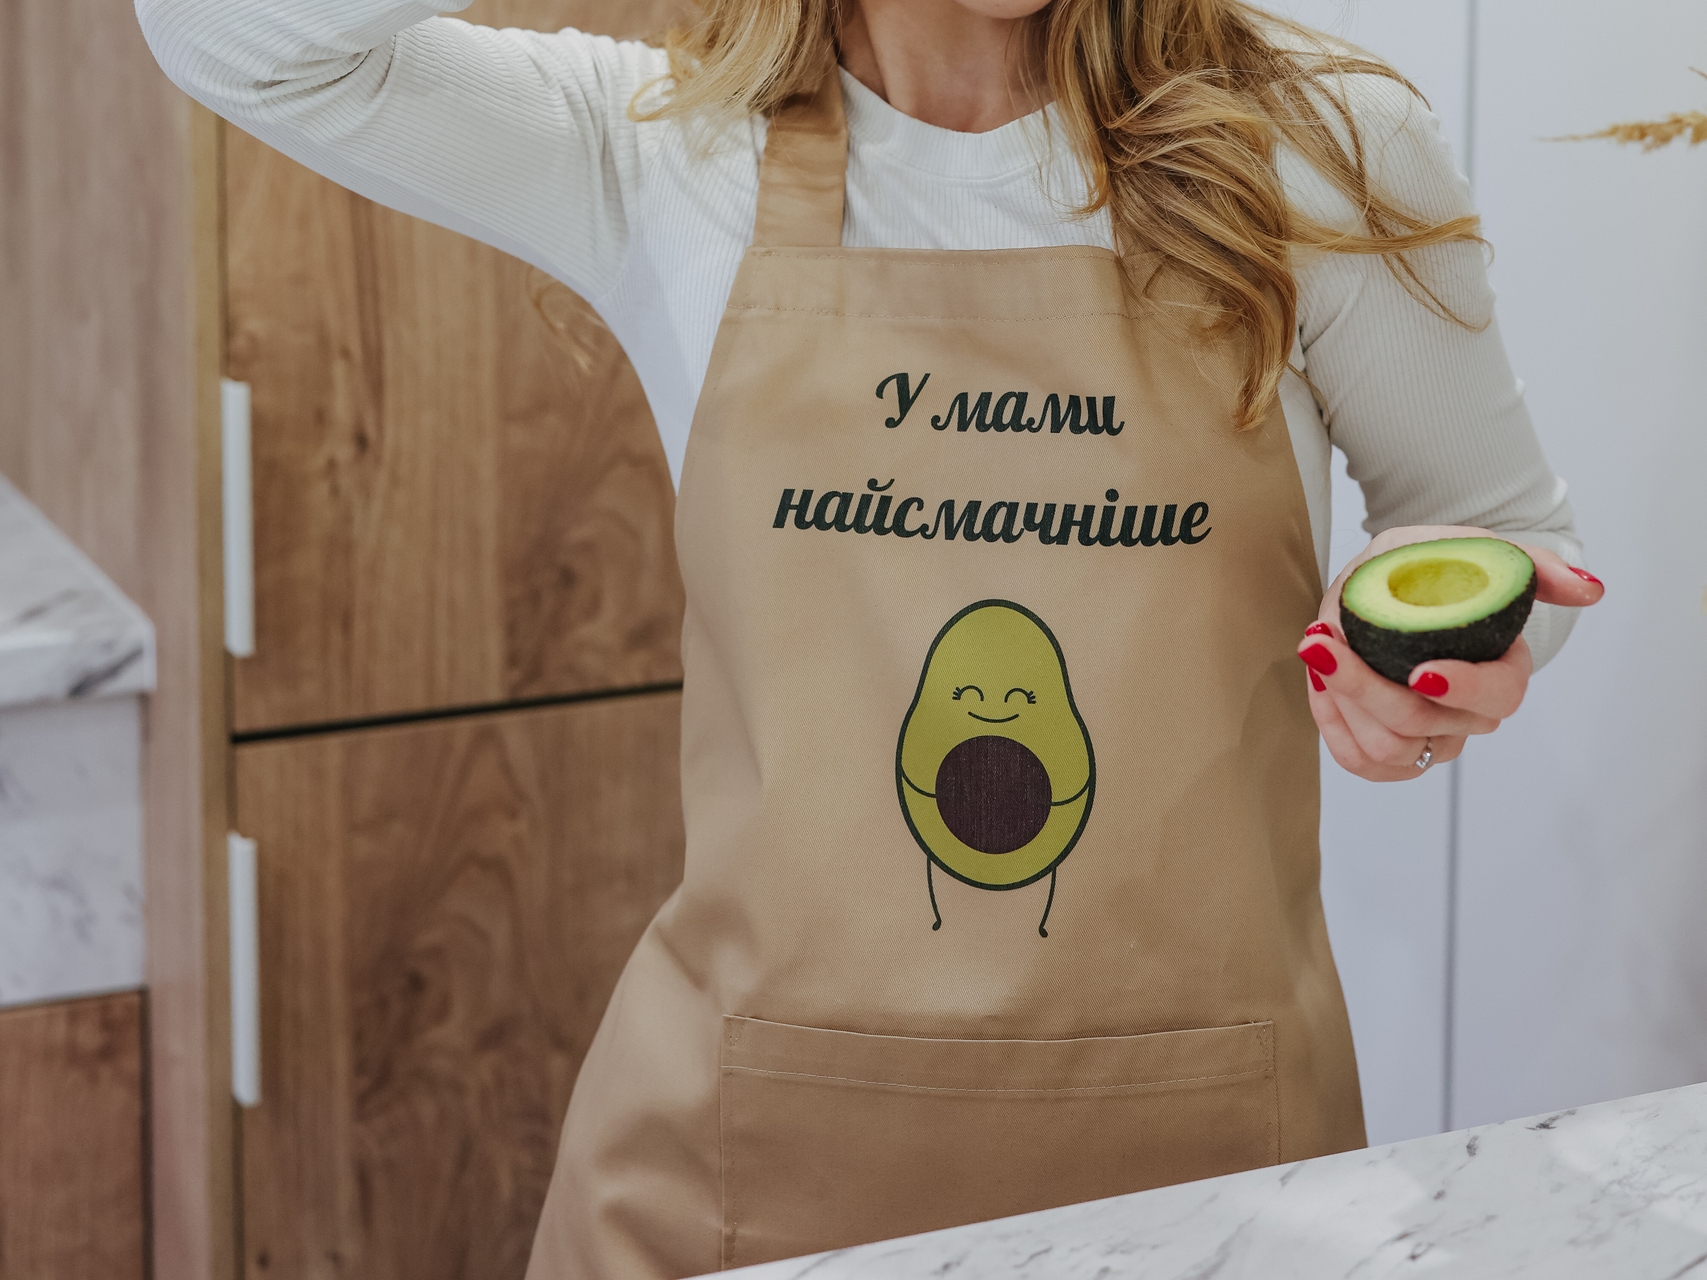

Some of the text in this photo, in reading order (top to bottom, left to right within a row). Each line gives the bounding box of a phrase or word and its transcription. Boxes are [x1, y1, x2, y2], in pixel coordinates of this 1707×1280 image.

[875, 372, 1126, 437] У мами
[772, 477, 1213, 548] найсмачніше
